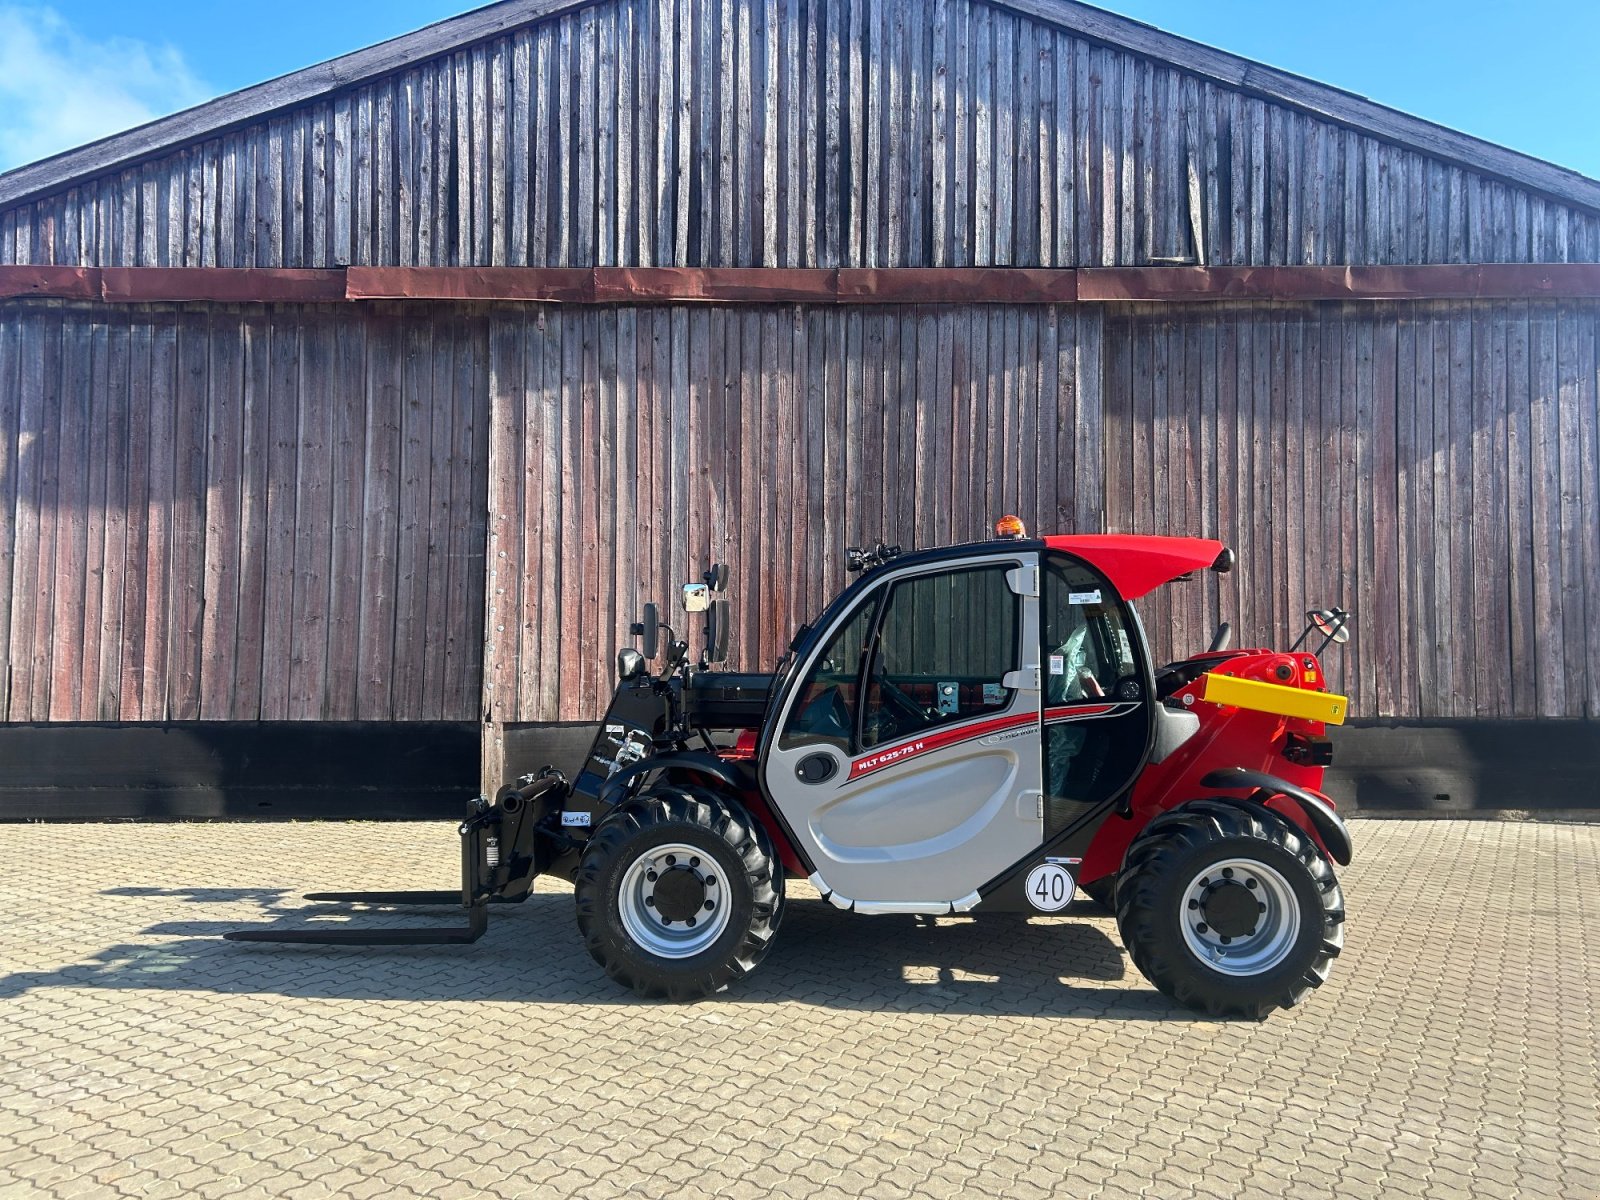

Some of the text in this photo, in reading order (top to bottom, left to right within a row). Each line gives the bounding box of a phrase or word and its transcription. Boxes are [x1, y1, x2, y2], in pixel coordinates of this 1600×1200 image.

[858, 742, 924, 770] MLT 625-75 H
[1035, 873, 1065, 902] 40
